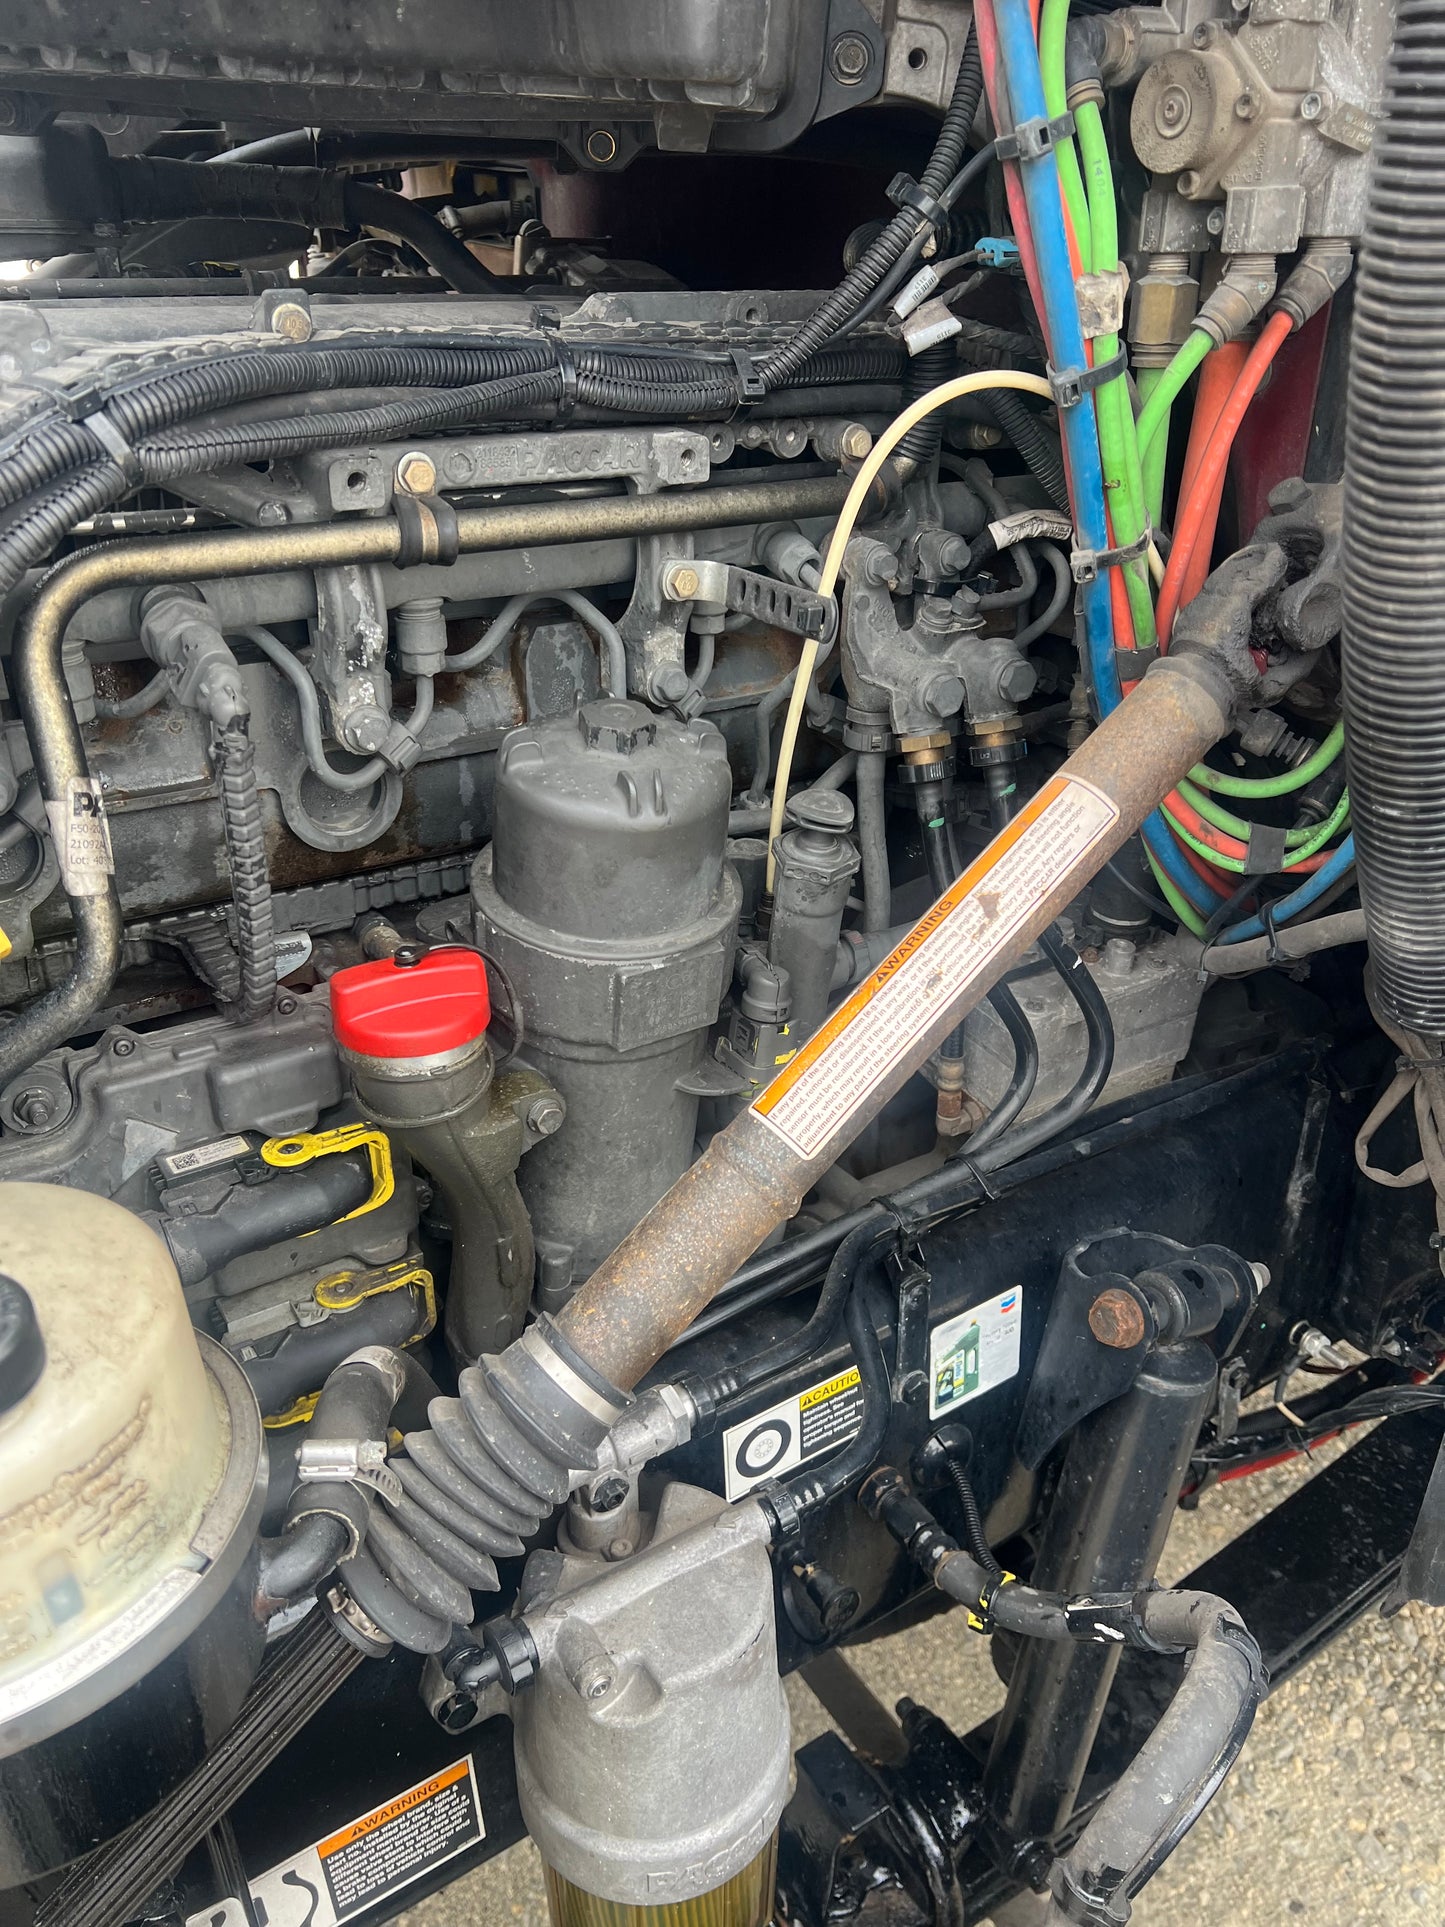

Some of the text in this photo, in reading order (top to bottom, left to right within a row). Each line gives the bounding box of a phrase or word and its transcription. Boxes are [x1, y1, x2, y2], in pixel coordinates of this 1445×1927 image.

[515, 438, 641, 477] PACCAR
[770, 1112, 778, 1120] If
[776, 1101, 790, 1114] any
[787, 1085, 803, 1102] part
[800, 1078, 809, 1087] of
[807, 1066, 820, 1079] the
[817, 1040, 845, 1068] steering
[841, 1016, 866, 1042] system
[876, 977, 902, 1004] linkage,
[899, 951, 926, 979] steering
[922, 923, 952, 953] driveline,
[948, 898, 975, 925] column,
[971, 868, 1001, 898] front-end
[997, 836, 1031, 870] alignment,
[1040, 815, 1049, 823] is
[1046, 797, 1066, 816] either
[777, 1095, 808, 1127] repaired,
[804, 1067, 833, 1097] removed
[831, 1059, 840, 1068] or
[838, 1015, 880, 1060] disassembled
[877, 1008, 886, 1016] in
[884, 996, 898, 1010] any
[896, 981, 912, 998] way,
[910, 973, 919, 981] or
[921, 955, 934, 968] the
[931, 930, 959, 957] steering
[955, 912, 975, 932] angle
[991, 882, 1001, 891] is
[997, 854, 1027, 885] replaced,
[1023, 843, 1037, 855] the
[1033, 818, 1060, 845] steering
[1056, 800, 1076, 820] angle
[786, 1109, 809, 1134] sensor
[806, 1091, 825, 1111] must
[821, 1082, 833, 1093] be
[830, 1042, 869, 1084] recalibrated.
[872, 1025, 885, 1038] the
[882, 985, 921, 1026] recalibration
[918, 978, 927, 986] is
[924, 966, 938, 980] not
[935, 934, 968, 969] performed
[964, 923, 978, 935] the
[997, 875, 1021, 899] control
[1017, 853, 1042, 877] system
[1038, 841, 1052, 854] will
[1049, 830, 1062, 842] not
[1059, 804, 1085, 831] function
[882, 898, 953, 972] WARNING
[793, 1109, 823, 1142] properly,
[820, 1089, 841, 1111] which
[839, 1075, 855, 1092] may
[851, 1055, 871, 1077] result
[868, 1048, 878, 1057] in
[880, 1029, 895, 1045] loss
[892, 1021, 903, 1030] of
[899, 998, 923, 1023] control
[920, 990, 930, 999] of
[941, 952, 965, 976] vehicle
[961, 940, 976, 954] and
[1015, 887, 1025, 895] or
[1022, 867, 1042, 887] death.
[1039, 853, 1056, 868] Any
[1051, 831, 1075, 855] repairs
[1072, 824, 1082, 832] or
[801, 1109, 838, 1149] adjustment
[834, 1101, 844, 1111] to
[842, 1089, 856, 1104] any
[852, 1074, 869, 1091] part
[865, 1066, 875, 1076] of
[873, 1055, 885, 1068] the
[883, 1029, 911, 1058] steering
[907, 1005, 932, 1031] system
[928, 988, 946, 1007] must
[943, 979, 954, 990] be
[951, 946, 985, 982] performed
[981, 938, 993, 948] by
[990, 929, 1000, 939] an
[997, 895, 1030, 930] authorized
[1027, 867, 1055, 896] PACCAR
[1052, 846, 1074, 869] dealer.
[813, 1372, 858, 1400] CAUTIO
[326, 1850, 344, 1865] Use
[345, 1838, 364, 1855] only
[365, 1829, 379, 1842] the
[380, 1814, 405, 1833] wheel
[434, 1788, 450, 1802] size
[328, 1792, 457, 1871] part no. installed by the original
[330, 1847, 375, 1878] equipment
[376, 1813, 432, 1850] manufacturer.
[434, 1803, 450, 1817] Use
[451, 1797, 459, 1807] of
[331, 1798, 470, 1883] different wheel brand or size could
[364, 1779, 439, 1829] WARNING
[333, 1871, 359, 1890] cause
[360, 1856, 382, 1874] valve
[384, 1844, 404, 1860] stem
[405, 1838, 414, 1848] to
[415, 1818, 449, 1842] interfere
[450, 1807, 467, 1821] with
[337, 1887, 355, 1901] lead
[356, 1880, 365, 1890] to
[366, 1869, 384, 1884] loss
[385, 1863, 395, 1873] of
[395, 1846, 424, 1867] vehicle
[425, 1828, 454, 1849] control
[455, 1819, 470, 1832] and
[338, 1893, 356, 1909] may
[357, 1881, 375, 1896] lead
[377, 1875, 386, 1885] to
[387, 1854, 422, 1880] personal
[423, 1839, 448, 1859] injury.
[342, 1873, 366, 1891] brake
[367, 1845, 413, 1877] component
[414, 1831, 438, 1849] which
[439, 1817, 462, 1834] could
